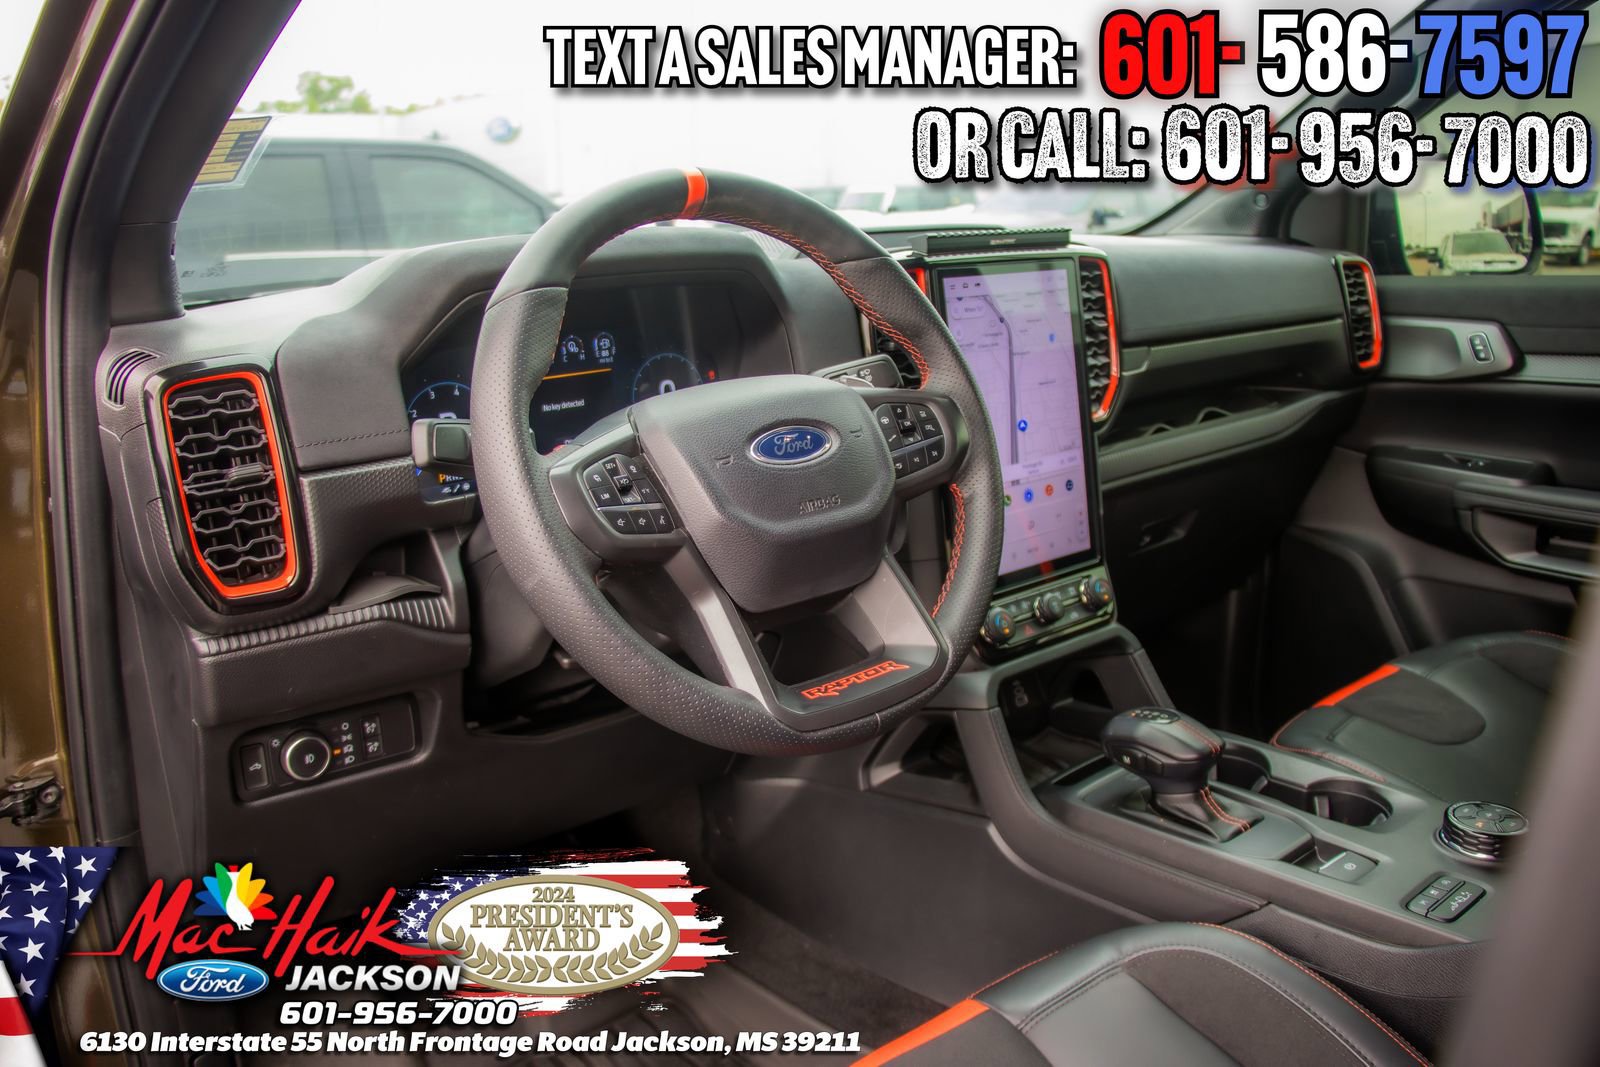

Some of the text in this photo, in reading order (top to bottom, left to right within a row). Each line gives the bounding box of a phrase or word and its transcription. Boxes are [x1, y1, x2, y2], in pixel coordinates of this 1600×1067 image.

[543, 399, 585, 412] No key detected
[773, 432, 814, 456] Ford
[798, 494, 841, 514] AIRBAG
[801, 660, 911, 699] RAPTOR
